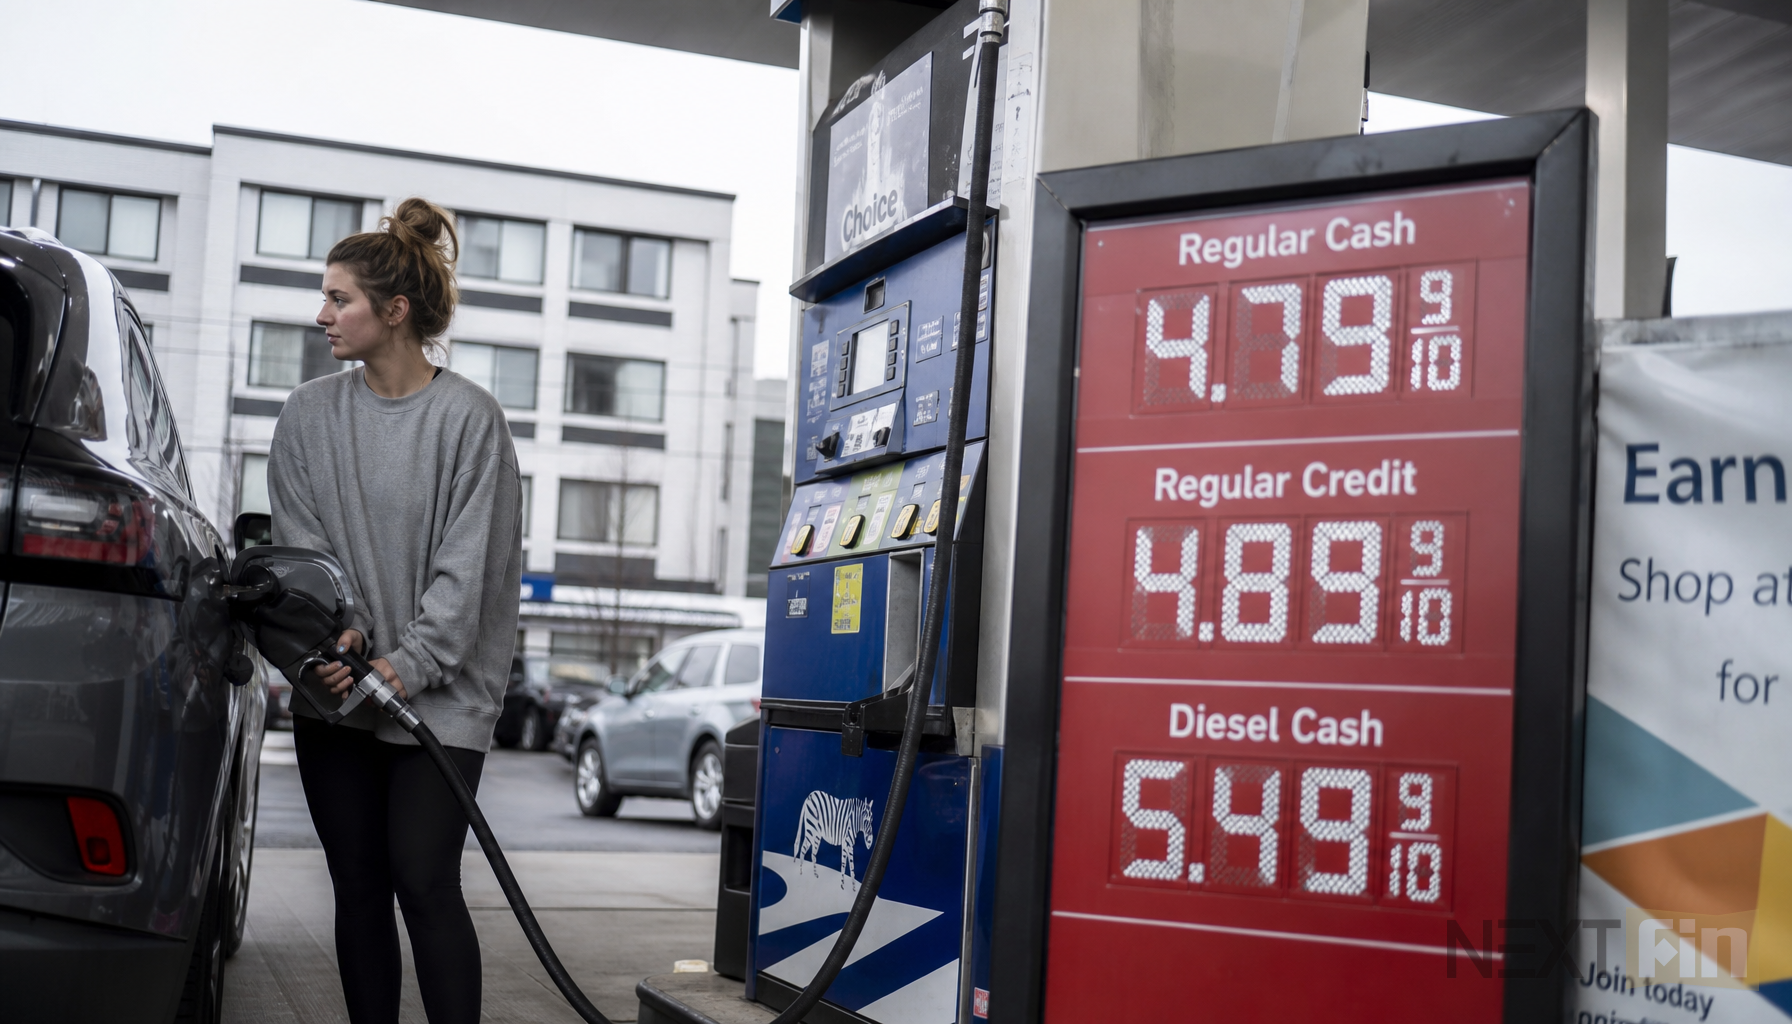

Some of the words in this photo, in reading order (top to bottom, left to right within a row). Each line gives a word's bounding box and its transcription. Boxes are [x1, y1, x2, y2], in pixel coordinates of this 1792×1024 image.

[842, 188, 898, 243] Choice
[1178, 223, 1315, 269] Regular
[1325, 210, 1417, 252] Cash
[1419, 269, 1454, 326] 9
[1145, 275, 1394, 404] 4.79
[1409, 333, 1463, 393] 10
[1154, 464, 1291, 508] Regular
[1302, 459, 1418, 498] Credit
[1623, 442, 1788, 505] Earn
[1409, 520, 1445, 577] 9
[1133, 520, 1383, 644] 4.89
[1617, 557, 1734, 616] Shop
[1399, 587, 1453, 646] 10
[1716, 659, 1780, 705] for
[1169, 703, 1280, 743] Diesel
[1291, 707, 1383, 747] Cash
[1121, 758, 1373, 896] 5.49
[1398, 772, 1434, 832] 9
[1388, 842, 1442, 903] 10
[1579, 962, 1635, 997] Join
[1642, 976, 1715, 1022] today
